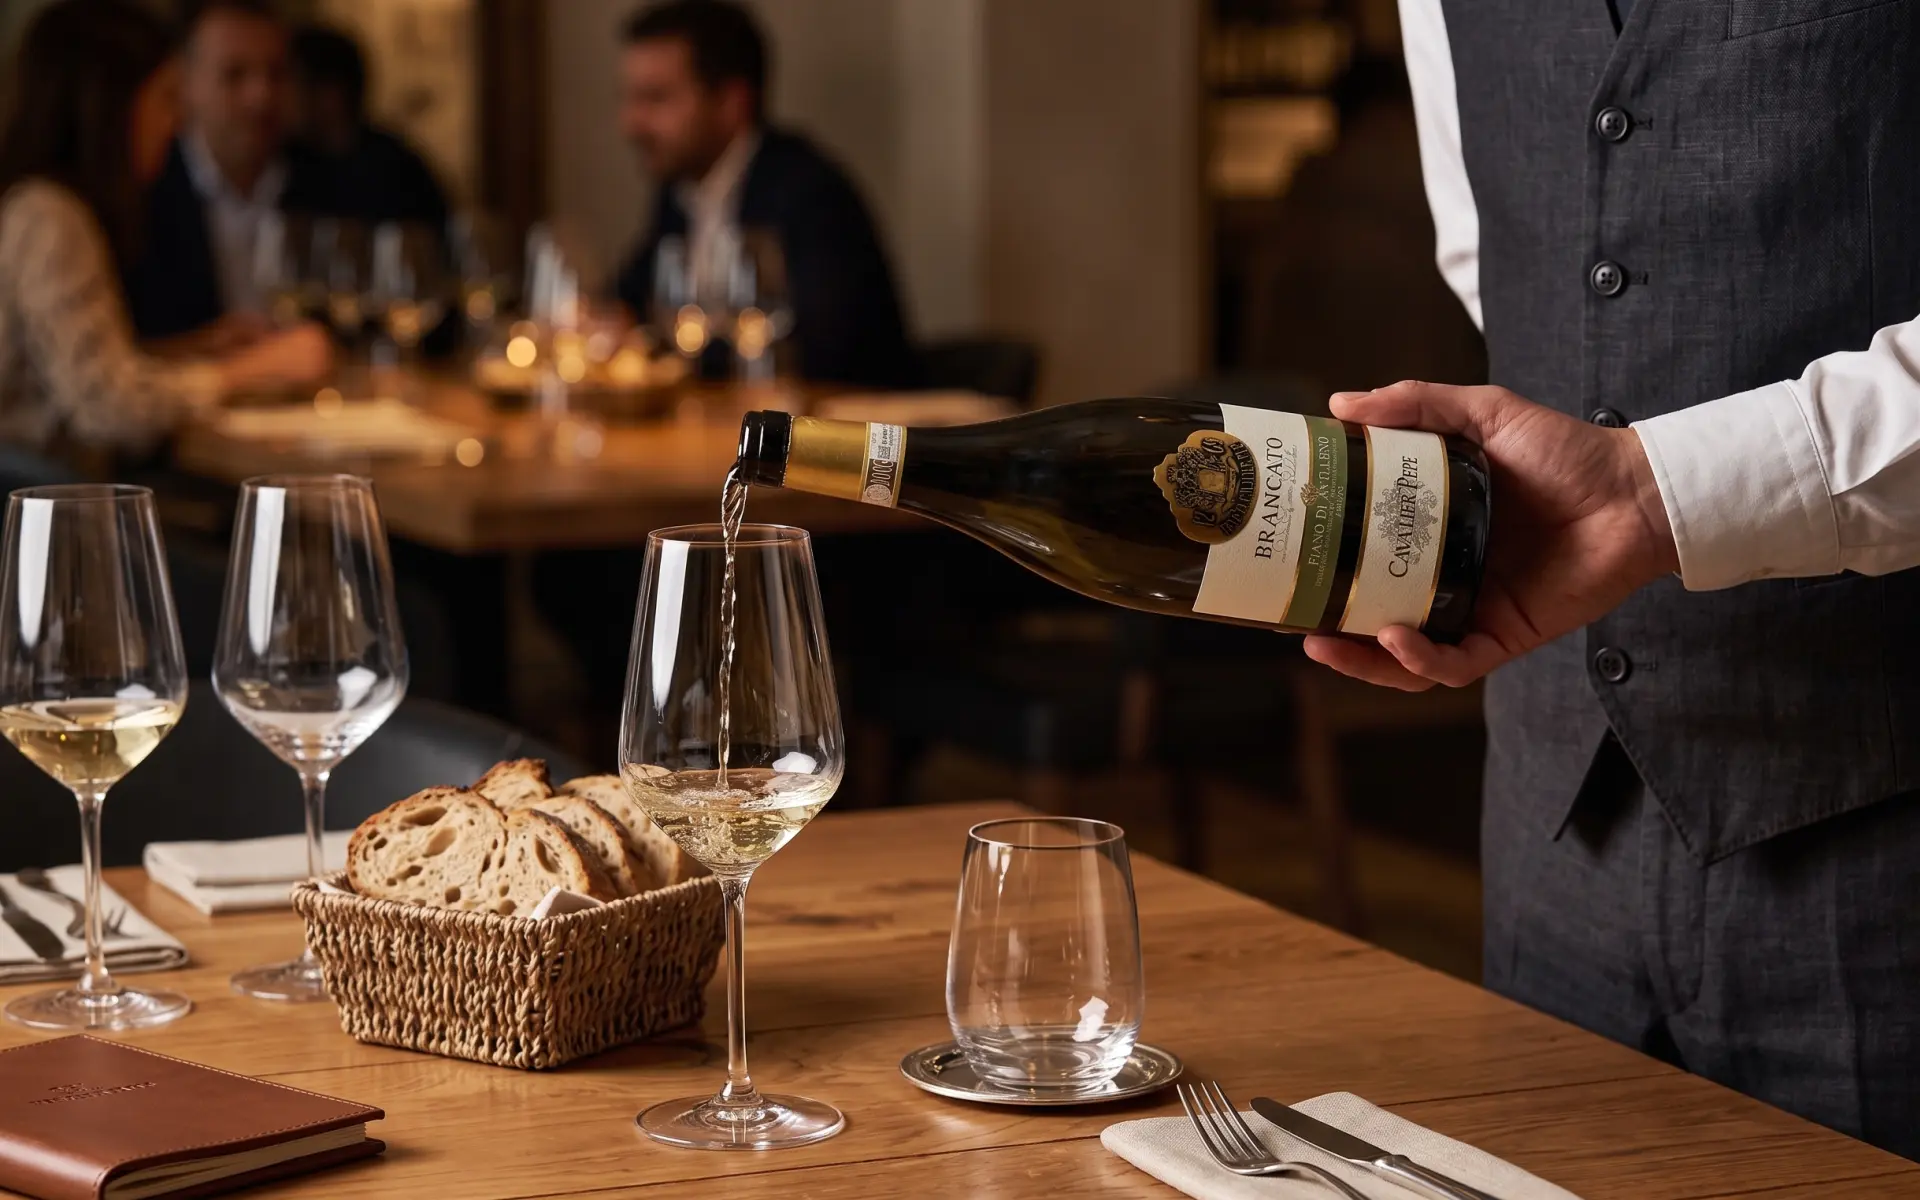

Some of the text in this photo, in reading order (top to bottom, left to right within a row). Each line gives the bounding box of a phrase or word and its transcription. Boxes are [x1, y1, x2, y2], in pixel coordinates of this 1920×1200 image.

[1254, 437, 1283, 560] BRANCATO
[1315, 504, 1327, 521] DI
[1388, 455, 1418, 578] CAVALIER PEPE
[1308, 523, 1325, 566] FIANO
